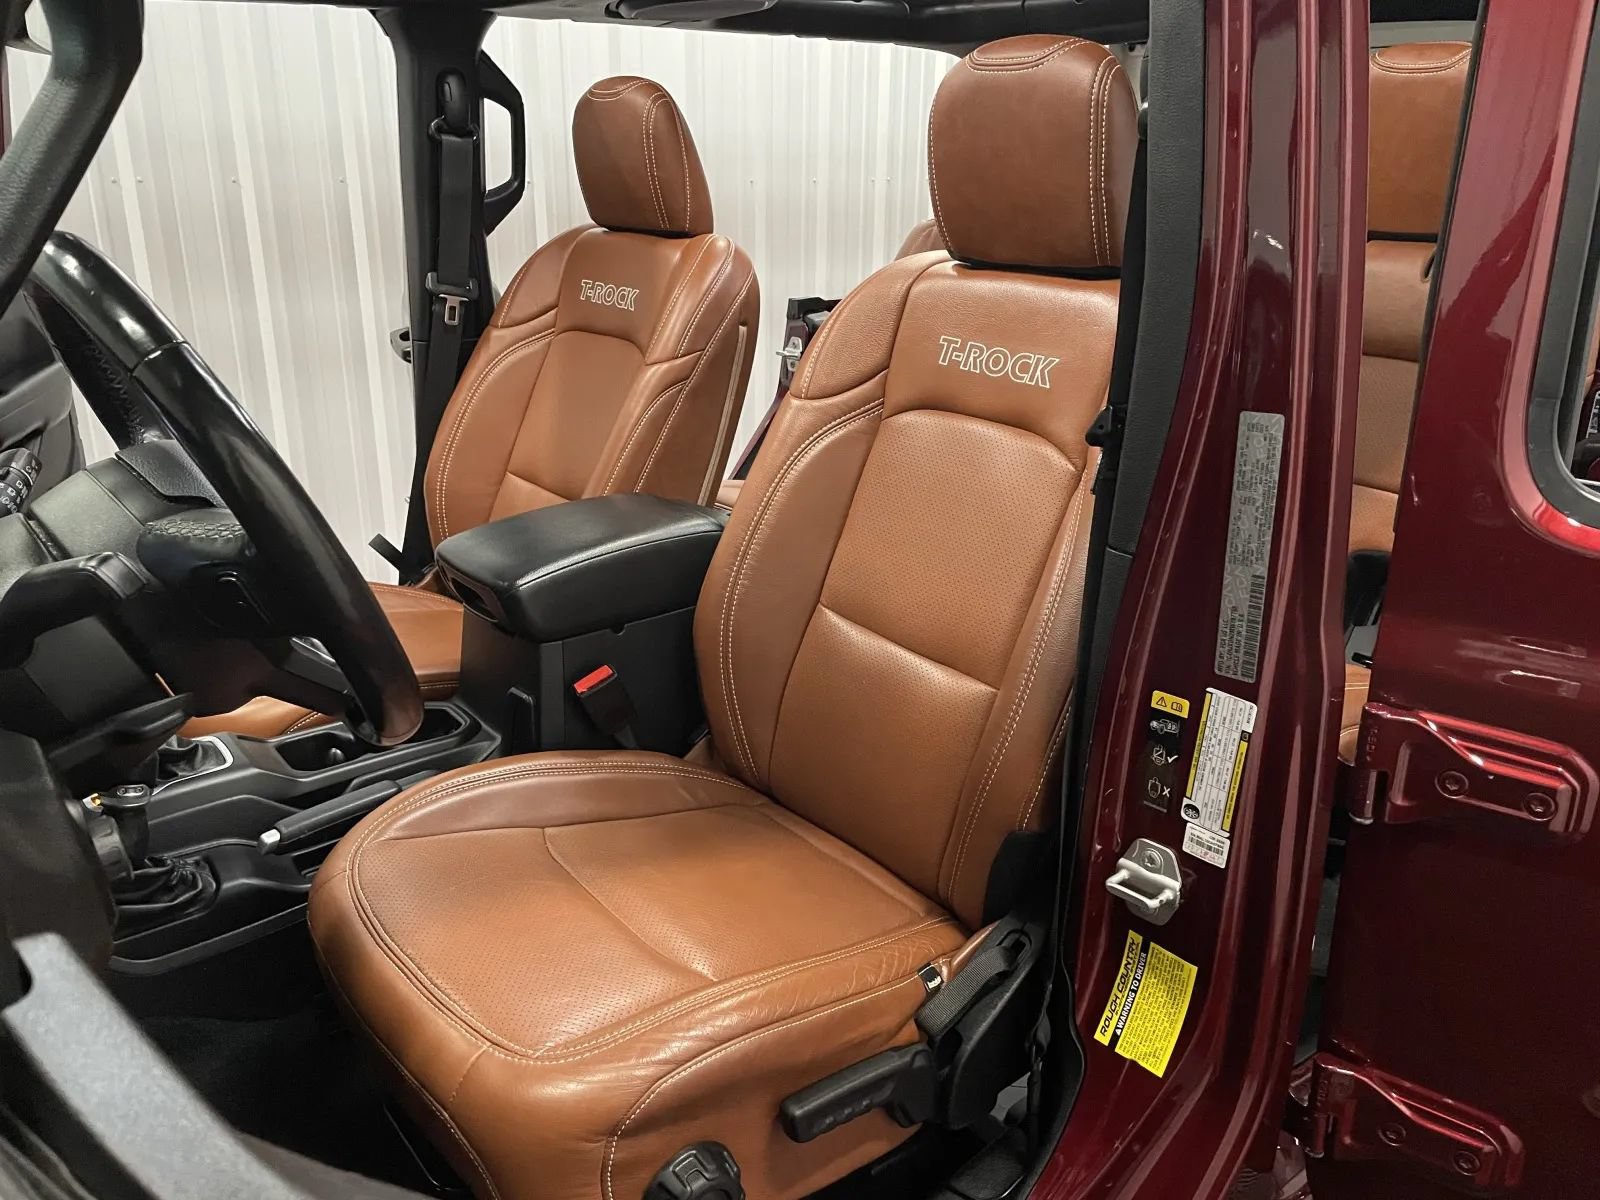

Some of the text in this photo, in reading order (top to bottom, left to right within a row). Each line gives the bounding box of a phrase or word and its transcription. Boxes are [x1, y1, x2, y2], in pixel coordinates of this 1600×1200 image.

[580, 279, 640, 311] T-ROCK
[938, 335, 1060, 388] T-ROCK
[1100, 936, 1136, 1037] ROUGH COUNTRY
[1116, 952, 1148, 1029] WARNING TO DRIVER
